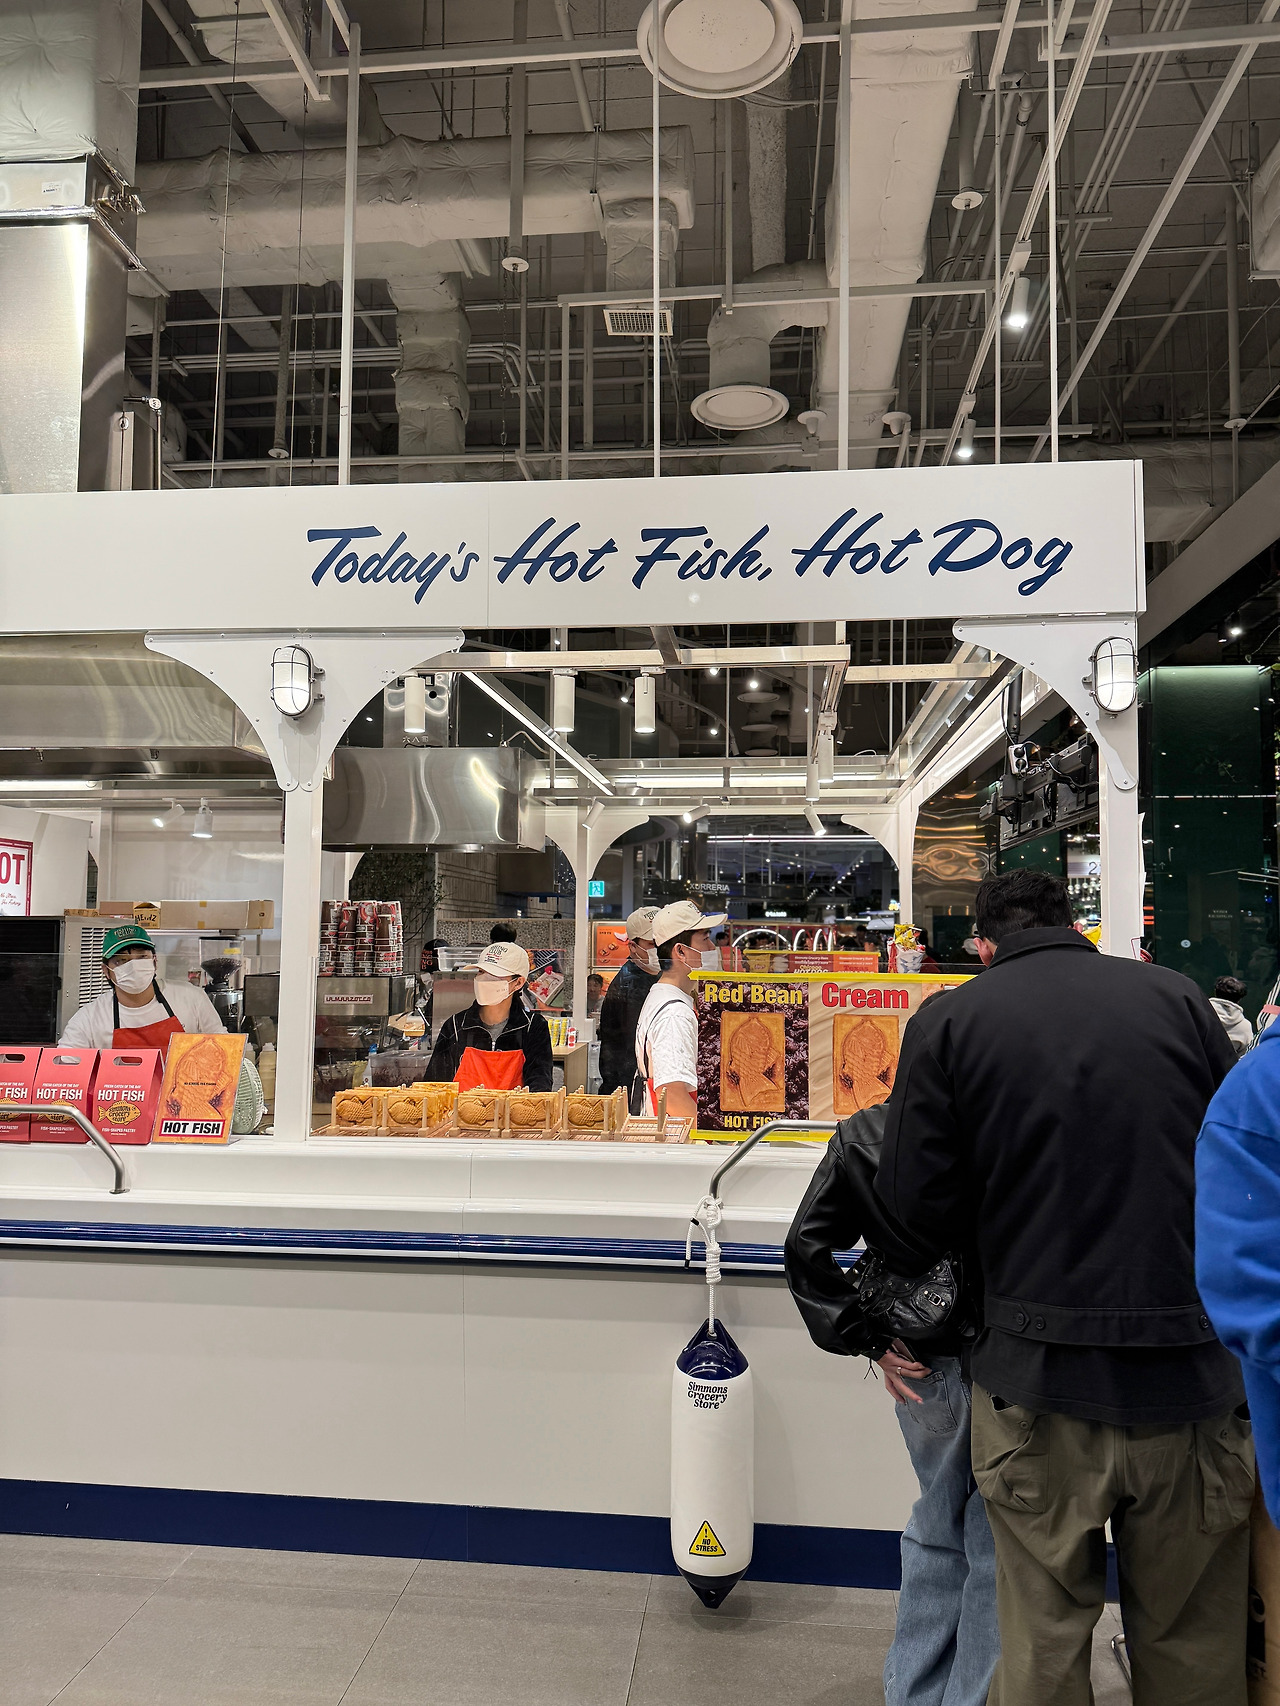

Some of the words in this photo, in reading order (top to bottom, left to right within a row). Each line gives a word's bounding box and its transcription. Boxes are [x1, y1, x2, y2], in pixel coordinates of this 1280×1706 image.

[306, 525, 480, 605] Today's
[493, 516, 619, 585] Hot
[631, 524, 773, 591] Fish,
[791, 507, 923, 578] Hot
[927, 518, 1073, 597] Dog
[0, 851, 25, 885] OT
[704, 983, 744, 1003] Red
[750, 985, 803, 1005] Bean
[821, 982, 909, 1009] Cream
[5, 1087, 28, 1099] FISH
[36, 1088, 57, 1099] HOT
[59, 1089, 83, 1100] FISH
[97, 1090, 119, 1101] HOT
[121, 1090, 145, 1102] FISH
[163, 1122, 189, 1133] HOT
[192, 1123, 221, 1134] FISH
[724, 1115, 749, 1128] HOT
[687, 1381, 728, 1394] Simmons
[687, 1390, 728, 1403] Grocery
[693, 1399, 720, 1410] Store
